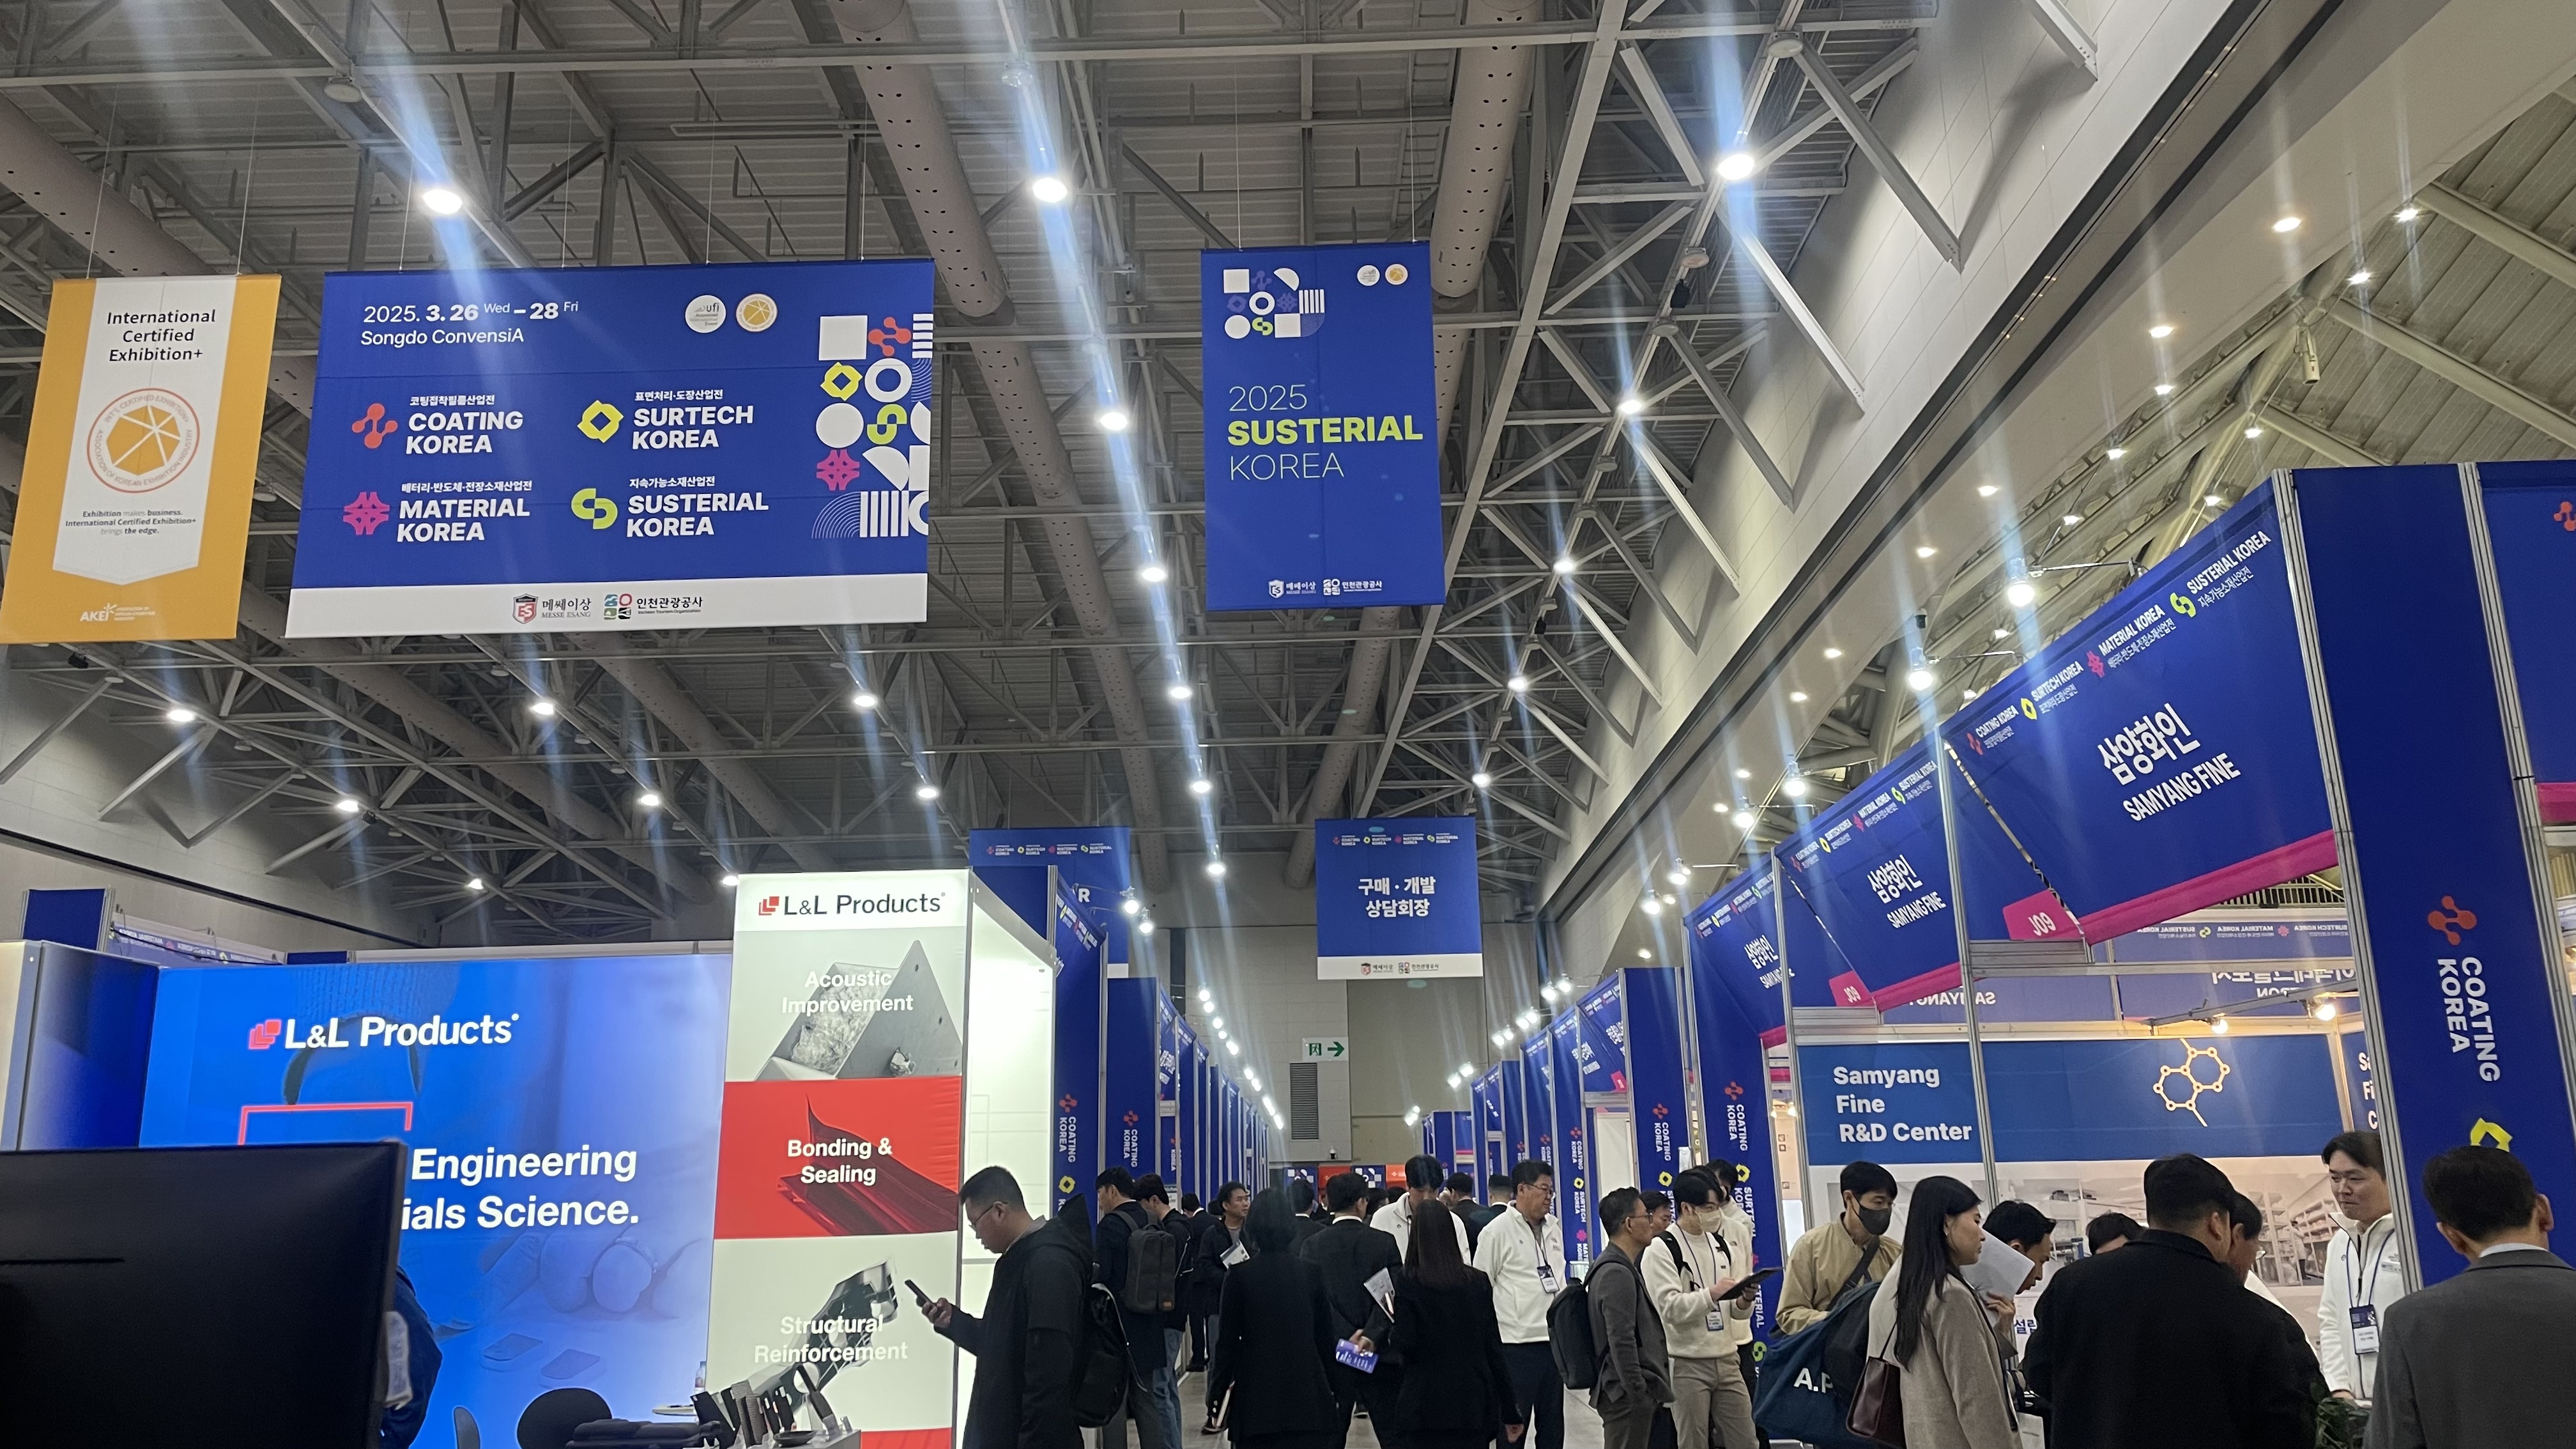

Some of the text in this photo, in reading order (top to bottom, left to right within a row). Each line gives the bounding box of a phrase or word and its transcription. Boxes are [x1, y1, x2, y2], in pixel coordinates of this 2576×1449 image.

[107, 309, 216, 325] International
[364, 301, 579, 323] 2025. 3. 26 Wed 28 Fri
[122, 328, 194, 342] Certified
[361, 328, 524, 348] Songdo ConvensiA
[109, 348, 203, 362] Exhibition+
[1229, 384, 1307, 412] 2025
[408, 411, 523, 431] COATING
[633, 405, 754, 427] SURTECH
[632, 429, 719, 450] KOREA
[1227, 415, 1423, 446] SUSTERIAL
[405, 434, 493, 455] KOREA
[1230, 452, 1344, 481] KOREA
[399, 498, 530, 519] MATERIAL
[627, 491, 769, 514] SUSTERIAL
[65, 518, 116, 526] International
[138, 527, 160, 535] edge.
[396, 522, 485, 542] KOREA
[627, 516, 715, 537] KOREA
[2186, 530, 2272, 595] SUSTERIAL KOREA
[542, 597, 592, 611] 메쎄이상
[636, 596, 703, 610] 인천관광공사
[2098, 624, 2138, 656] MATERIAL
[2133, 604, 2166, 632] KOREA
[2030, 675, 2064, 702] SURTECH
[2059, 661, 2084, 684] KOREA
[1975, 717, 2000, 738] COATING
[1997, 704, 2020, 727] KOREA
[2096, 702, 2202, 786] 삼양화인
[2122, 752, 2242, 822] SAMYANG FINE
[1358, 876, 1436, 896] 구매 개발
[1867, 854, 1923, 904] 삼양화인
[783, 896, 827, 916] L&L
[1365, 898, 1430, 919] 상담회장
[1886, 891, 1946, 929] SAMYANG FINE
[2030, 912, 2055, 937] J09
[804, 970, 893, 988] Acoustic
[781, 994, 914, 1017] Improvement
[2437, 958, 2471, 1054] KOREA
[2462, 956, 2501, 1082] COATING
[284, 1016, 349, 1049] L&L
[1833, 1066, 1940, 1089] Samyang
[1836, 1095, 1885, 1114] Fine
[1726, 1105, 1738, 1141] KOREA
[1736, 1104, 1748, 1151] COATING
[1839, 1122, 1973, 1143] R&D Center
[1059, 1117, 1068, 1153] KOREA
[1068, 1116, 1077, 1163] COATING
[1654, 1122, 1663, 1153] KOREA
[1661, 1122, 1671, 1162] COATING
[787, 1137, 893, 1159] Bonding &
[411, 1144, 638, 1188] Engineering
[800, 1165, 877, 1186] Sealing
[1734, 1187, 1744, 1209] KOR
[477, 1193, 640, 1229] Science.
[1754, 1285, 1765, 1328] TERIAL
[779, 1314, 884, 1335] Structural
[754, 1342, 908, 1364] Reinforcement
